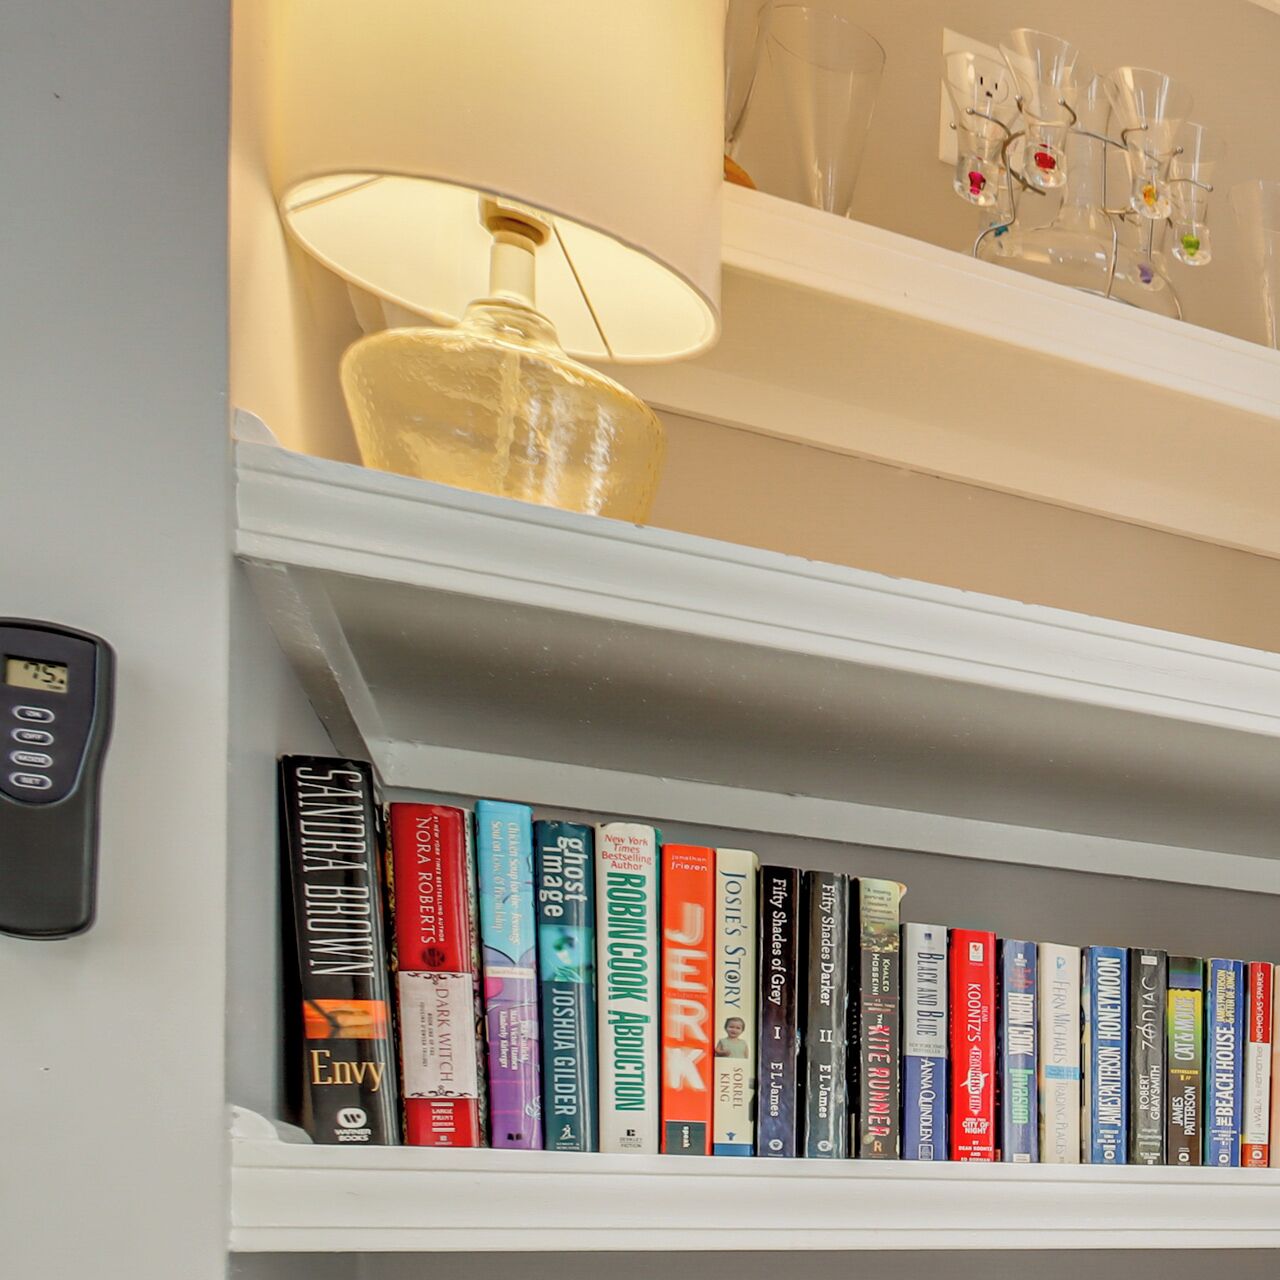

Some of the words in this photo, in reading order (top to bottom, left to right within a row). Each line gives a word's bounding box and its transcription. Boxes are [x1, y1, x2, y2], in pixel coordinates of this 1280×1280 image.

[296, 767, 367, 872] SANDRA
[415, 817, 433, 864] NORA
[602, 851, 652, 865] Bestselling
[604, 834, 625, 844] New
[628, 836, 648, 846] York
[614, 843, 640, 854] Times
[557, 837, 588, 902] ghost
[610, 860, 643, 870] Author
[670, 862, 708, 872] friesen
[417, 872, 436, 944] ROBERTS
[436, 876, 444, 915] BESTSELLING
[607, 872, 647, 941] ROBIN
[720, 871, 748, 936] JOSIE'S
[771, 878, 786, 908] Fifty
[819, 883, 835, 912] Fifty
[304, 883, 375, 979] BROWN
[437, 917, 445, 942] AUTHOR
[771, 911, 786, 955] Shades
[821, 916, 833, 960] Shades
[607, 942, 649, 1002] COOK
[724, 945, 747, 1010] STORY
[772, 959, 786, 972] of
[820, 962, 834, 1006] Darker
[872, 953, 880, 996] HOSSEINI
[882, 959, 890, 993] KHALED
[916, 952, 944, 985] BLACK
[664, 902, 709, 1093] JERK
[769, 974, 784, 1006] Grey
[917, 987, 938, 1006] AND
[1052, 980, 1069, 1010] FERN
[1098, 957, 1121, 1040] HONEYMOON
[1216, 969, 1226, 1003] PATTERSON
[1256, 971, 1264, 1000] SPARKS
[435, 987, 450, 1028] DARK
[552, 988, 577, 1050] JOSHUA
[916, 1009, 944, 1037] BLUE
[967, 983, 982, 1042] KOONTZ'S
[1008, 992, 1035, 1024] ROBIN
[1136, 976, 1156, 1050] ZODIAC
[1174, 996, 1194, 1032] MOUSE
[1256, 1001, 1264, 1042] NICHOLAS
[867, 1025, 892, 1064] KITE
[1008, 1026, 1034, 1056] COOK
[1052, 1012, 1070, 1064] MICHAELS
[1174, 1044, 1194, 1060] CAT
[1175, 1033, 1192, 1042] &
[1215, 1027, 1234, 1070] HOUSE
[310, 1050, 385, 1092] Envy
[438, 1033, 454, 1082] WITCH
[608, 1010, 652, 1111] ABDUCTION
[771, 1062, 782, 1070] E
[820, 1064, 832, 1072] E
[920, 1057, 936, 1090] ANNA
[1098, 1046, 1121, 1097] PATTERSON
[554, 1055, 577, 1115] GILDER
[720, 1073, 730, 1103] KING
[732, 1066, 744, 1110] SORREL
[969, 1049, 981, 1110] FRANKENSTEIN
[1009, 1067, 1034, 1124] Invasion
[1140, 1074, 1150, 1110] ROBERT
[1150, 1065, 1160, 1120] GRAYSMITH
[1215, 1072, 1234, 1116] BEACH
[770, 1082, 783, 1117] James
[818, 1083, 831, 1118] James
[868, 1067, 891, 1136] RUNNER
[918, 1089, 936, 1142] QUINDLEN
[1055, 1082, 1067, 1120] TRADING
[1098, 1097, 1121, 1126] JAMES
[1172, 1097, 1183, 1126] JAMES
[1184, 1086, 1196, 1136] PATTERSON
[1055, 1122, 1067, 1156] PLACES
[1216, 1116, 1233, 1126] THE
